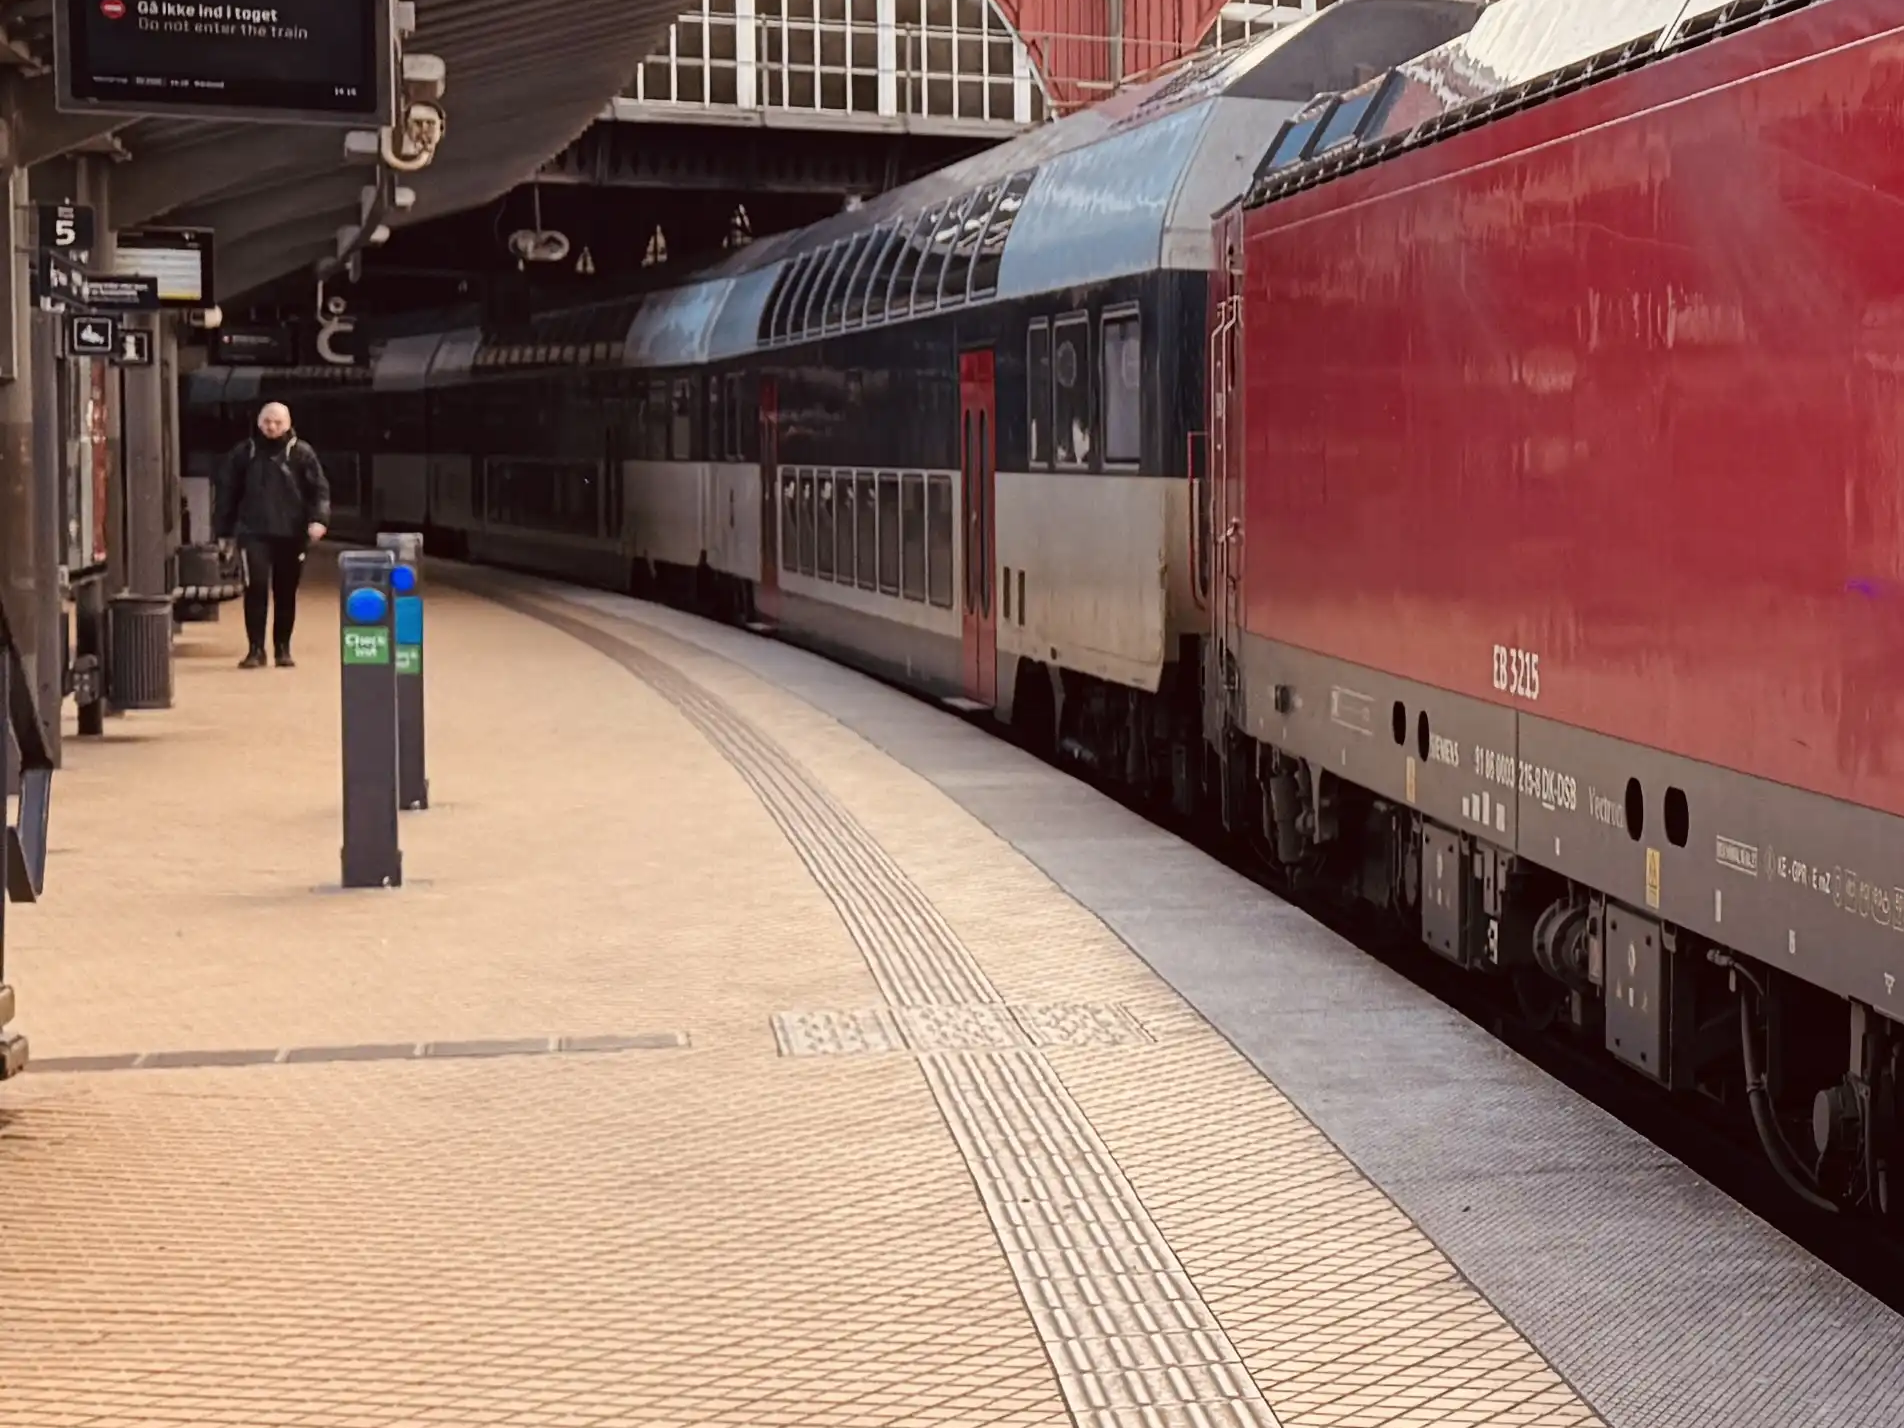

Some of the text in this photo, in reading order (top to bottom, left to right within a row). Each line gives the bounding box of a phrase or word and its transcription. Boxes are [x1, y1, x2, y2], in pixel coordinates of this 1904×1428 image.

[137, 0, 158, 15] Gå
[235, 7, 277, 23] toget
[139, 17, 308, 40] Do not enter the train
[56, 220, 75, 246] 5
[1494, 644, 1539, 700] EB 3215
[1518, 760, 1541, 799] 215-8
[1542, 767, 1577, 811] DK-DSB
